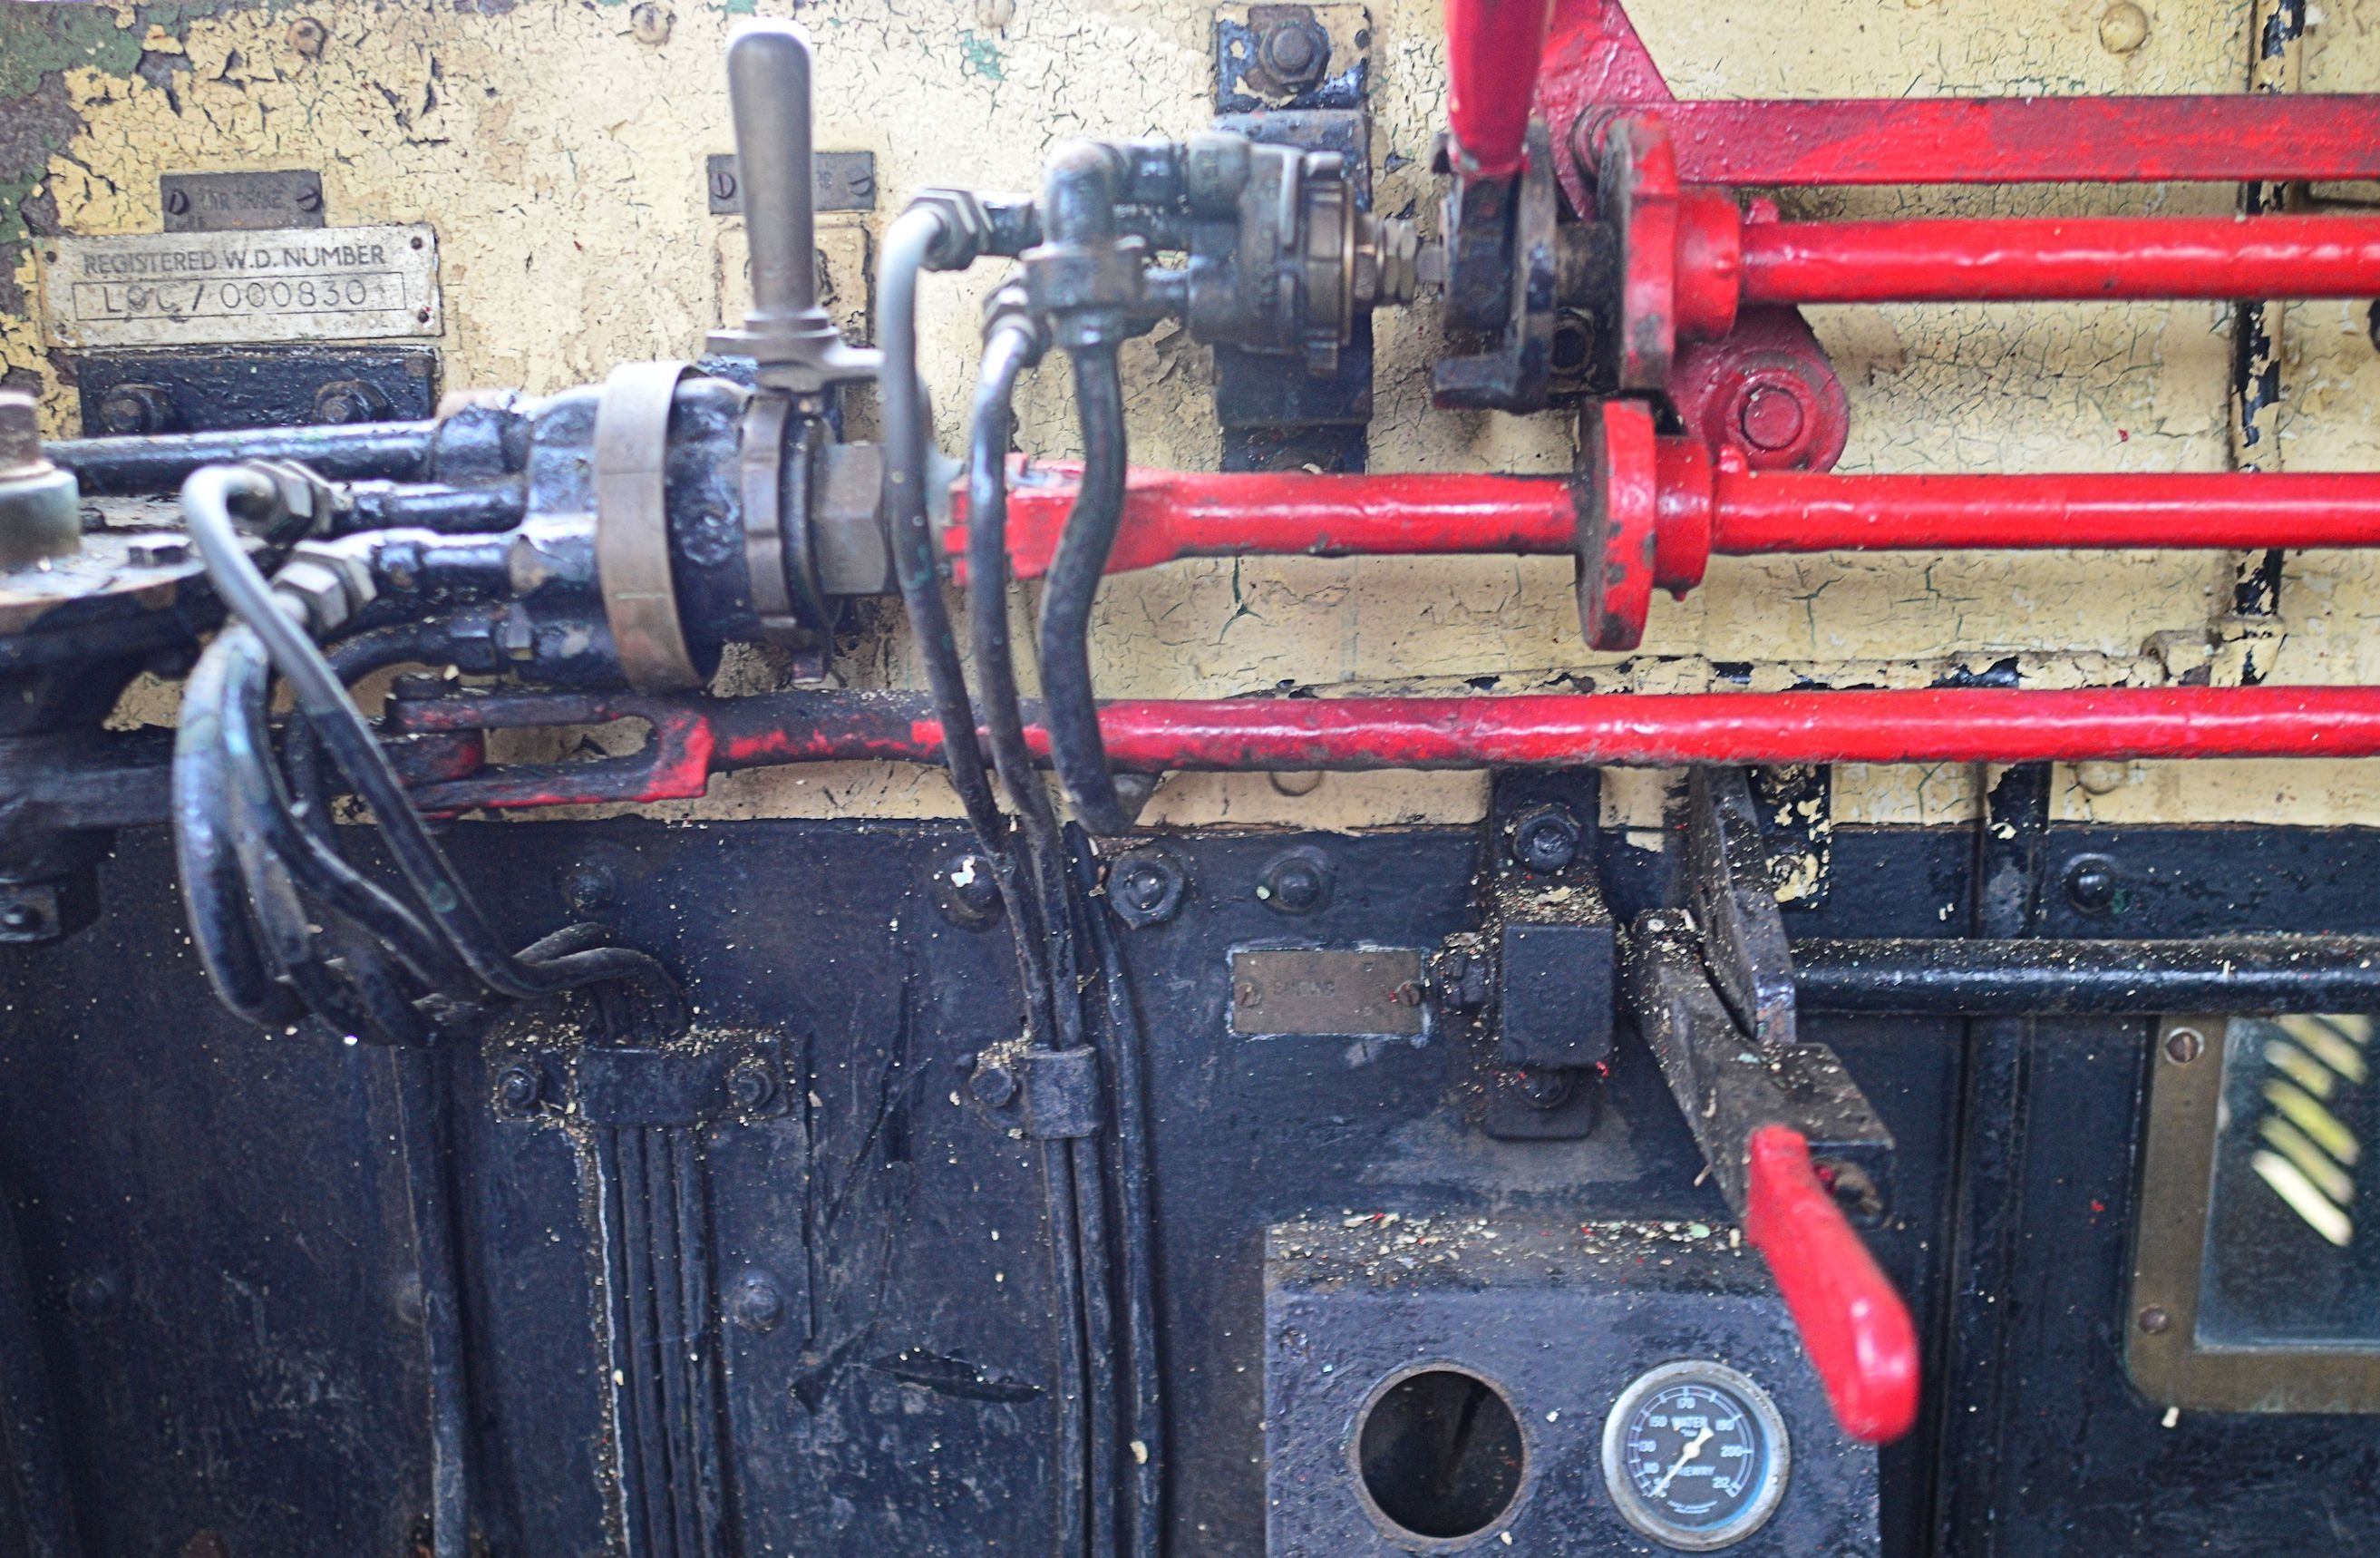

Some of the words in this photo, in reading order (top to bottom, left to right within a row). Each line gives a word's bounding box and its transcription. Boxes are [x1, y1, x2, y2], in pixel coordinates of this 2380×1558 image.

[83, 250, 218, 275] REGISTERED
[224, 248, 277, 269] W.D.
[283, 245, 384, 268] NUMBER
